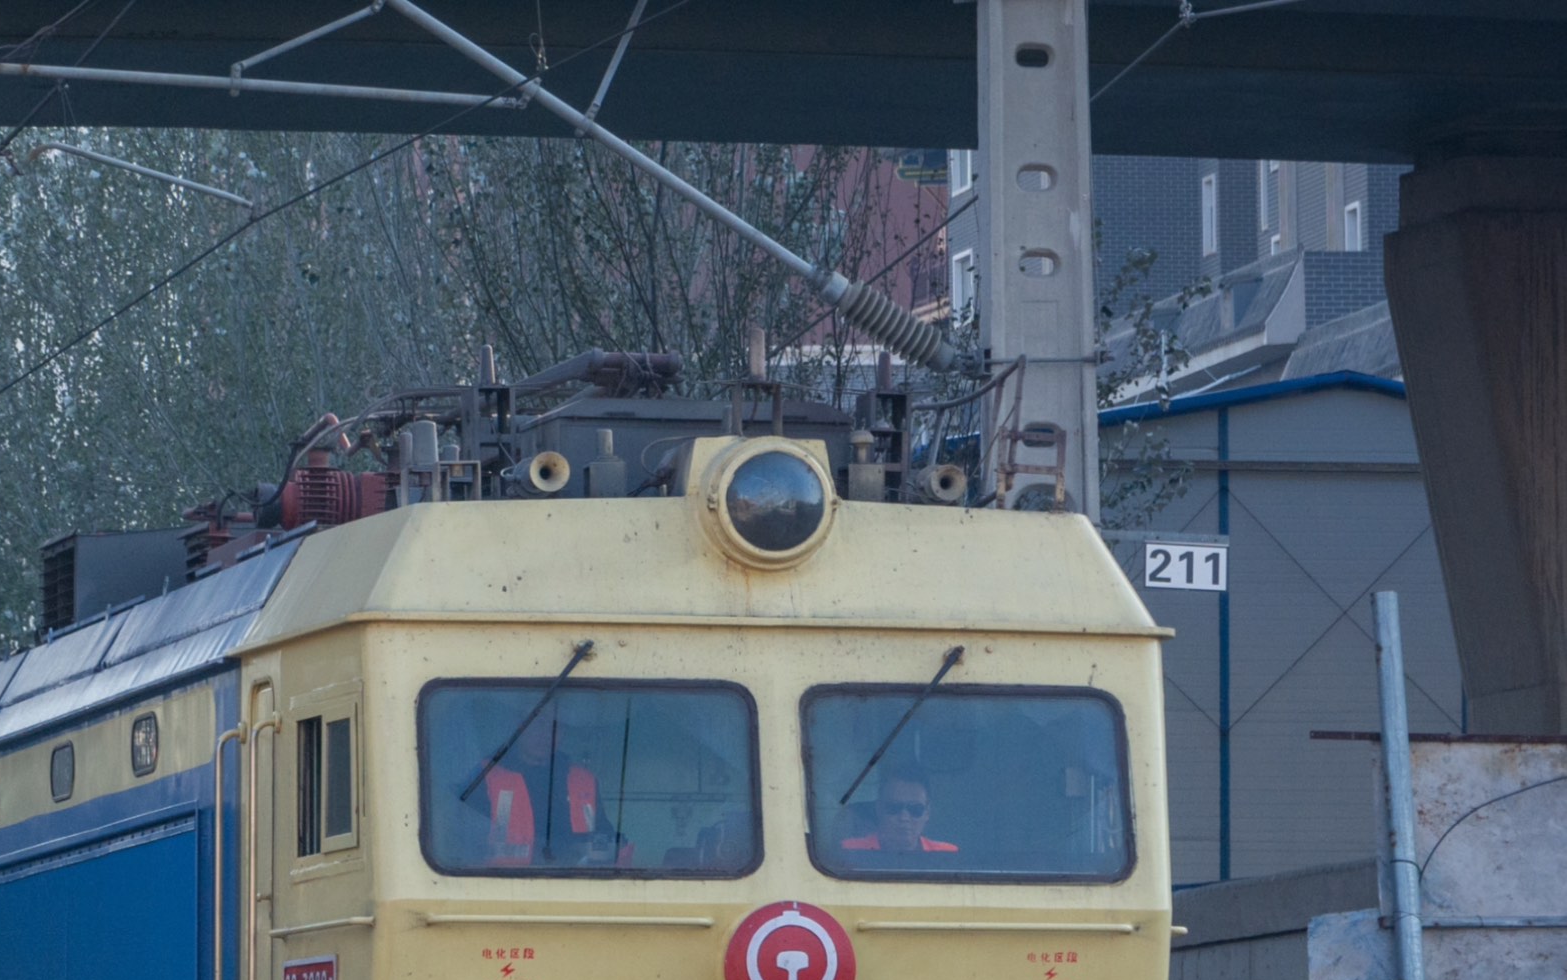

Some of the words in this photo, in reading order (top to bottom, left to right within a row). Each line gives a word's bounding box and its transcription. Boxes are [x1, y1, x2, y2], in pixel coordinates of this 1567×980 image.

[1148, 549, 1220, 586] 211
[481, 947, 535, 960] 电化区段
[1026, 951, 1079, 963] 电化区段
